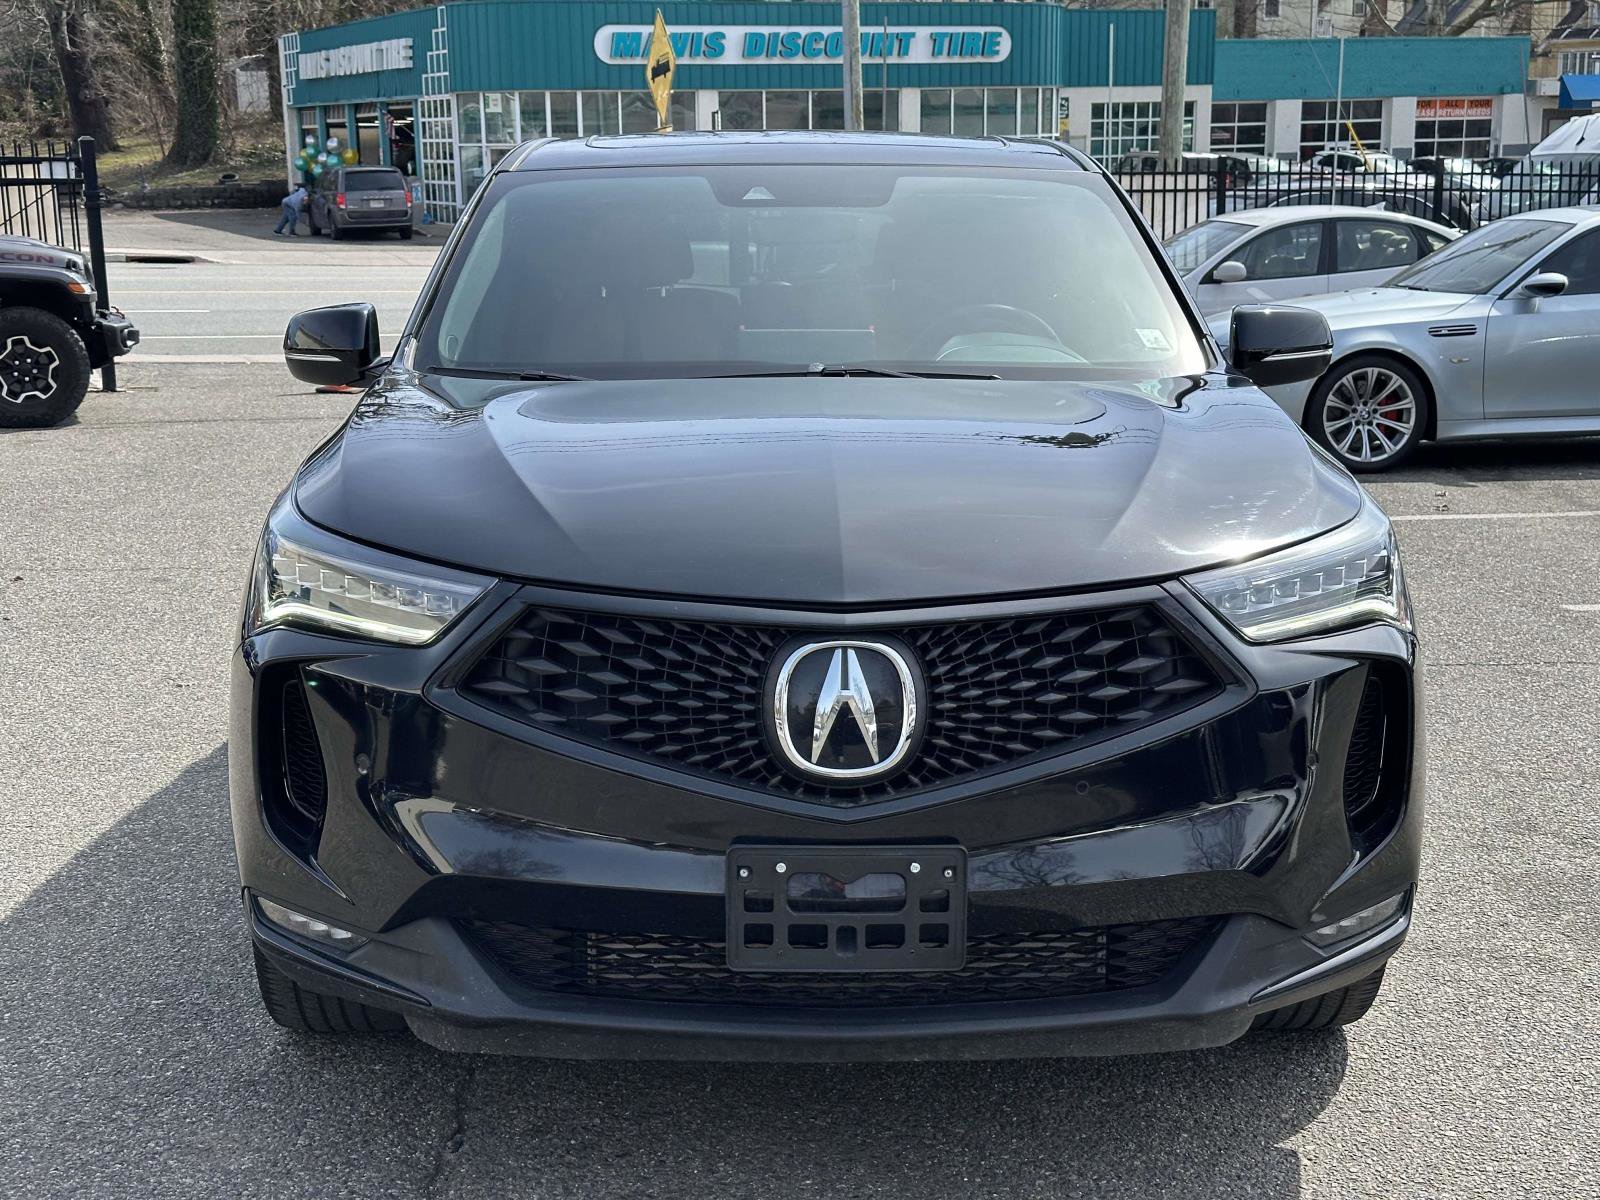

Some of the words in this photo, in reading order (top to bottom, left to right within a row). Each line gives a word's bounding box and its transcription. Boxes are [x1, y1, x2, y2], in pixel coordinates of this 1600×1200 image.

[610, 31, 726, 59] MVIS
[743, 31, 916, 59] DISCOUNT
[930, 31, 1003, 59] TIRE
[1445, 99, 1459, 108] ALL
[1470, 99, 1490, 107] YOUR
